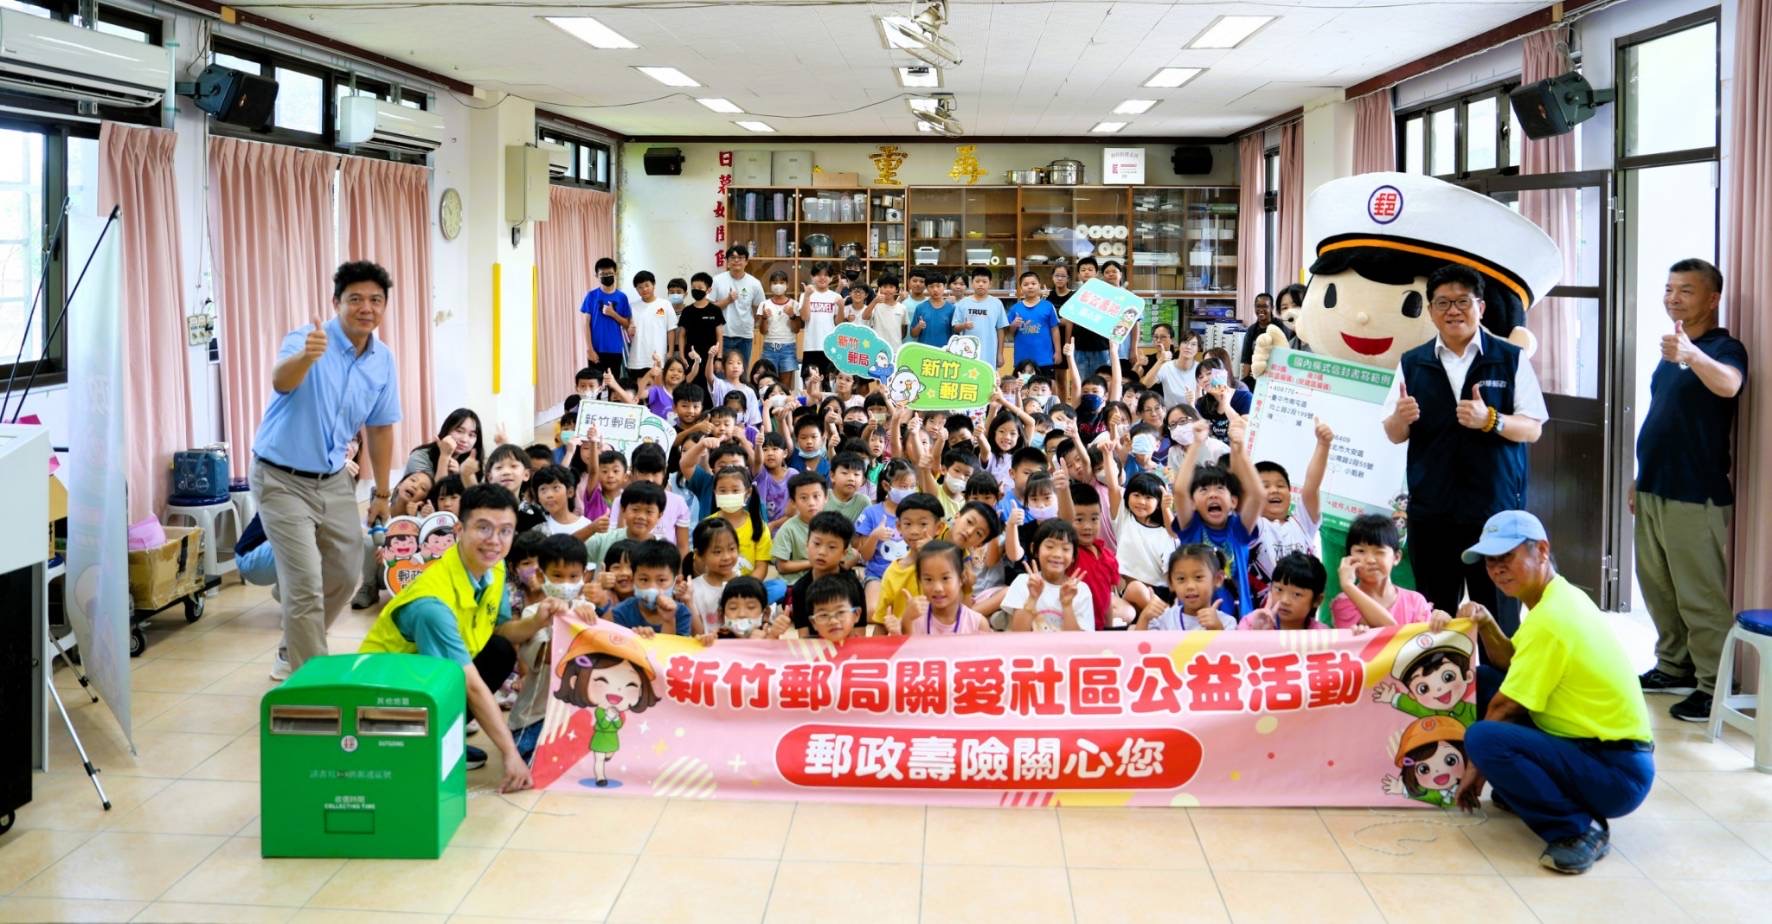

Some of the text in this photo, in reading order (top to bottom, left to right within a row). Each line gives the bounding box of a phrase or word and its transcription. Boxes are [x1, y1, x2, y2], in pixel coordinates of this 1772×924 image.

[968, 308, 988, 316] TRUE
[837, 335, 860, 349] 新竹
[847, 351, 869, 367] 郵局
[921, 357, 961, 380] 新竹
[938, 380, 979, 402] 郵局
[585, 413, 637, 430] 新竹郵局
[665, 652, 1364, 716] 新竹郵局關愛社區公益活動
[804, 732, 1165, 781] 郵政壽險關心您
